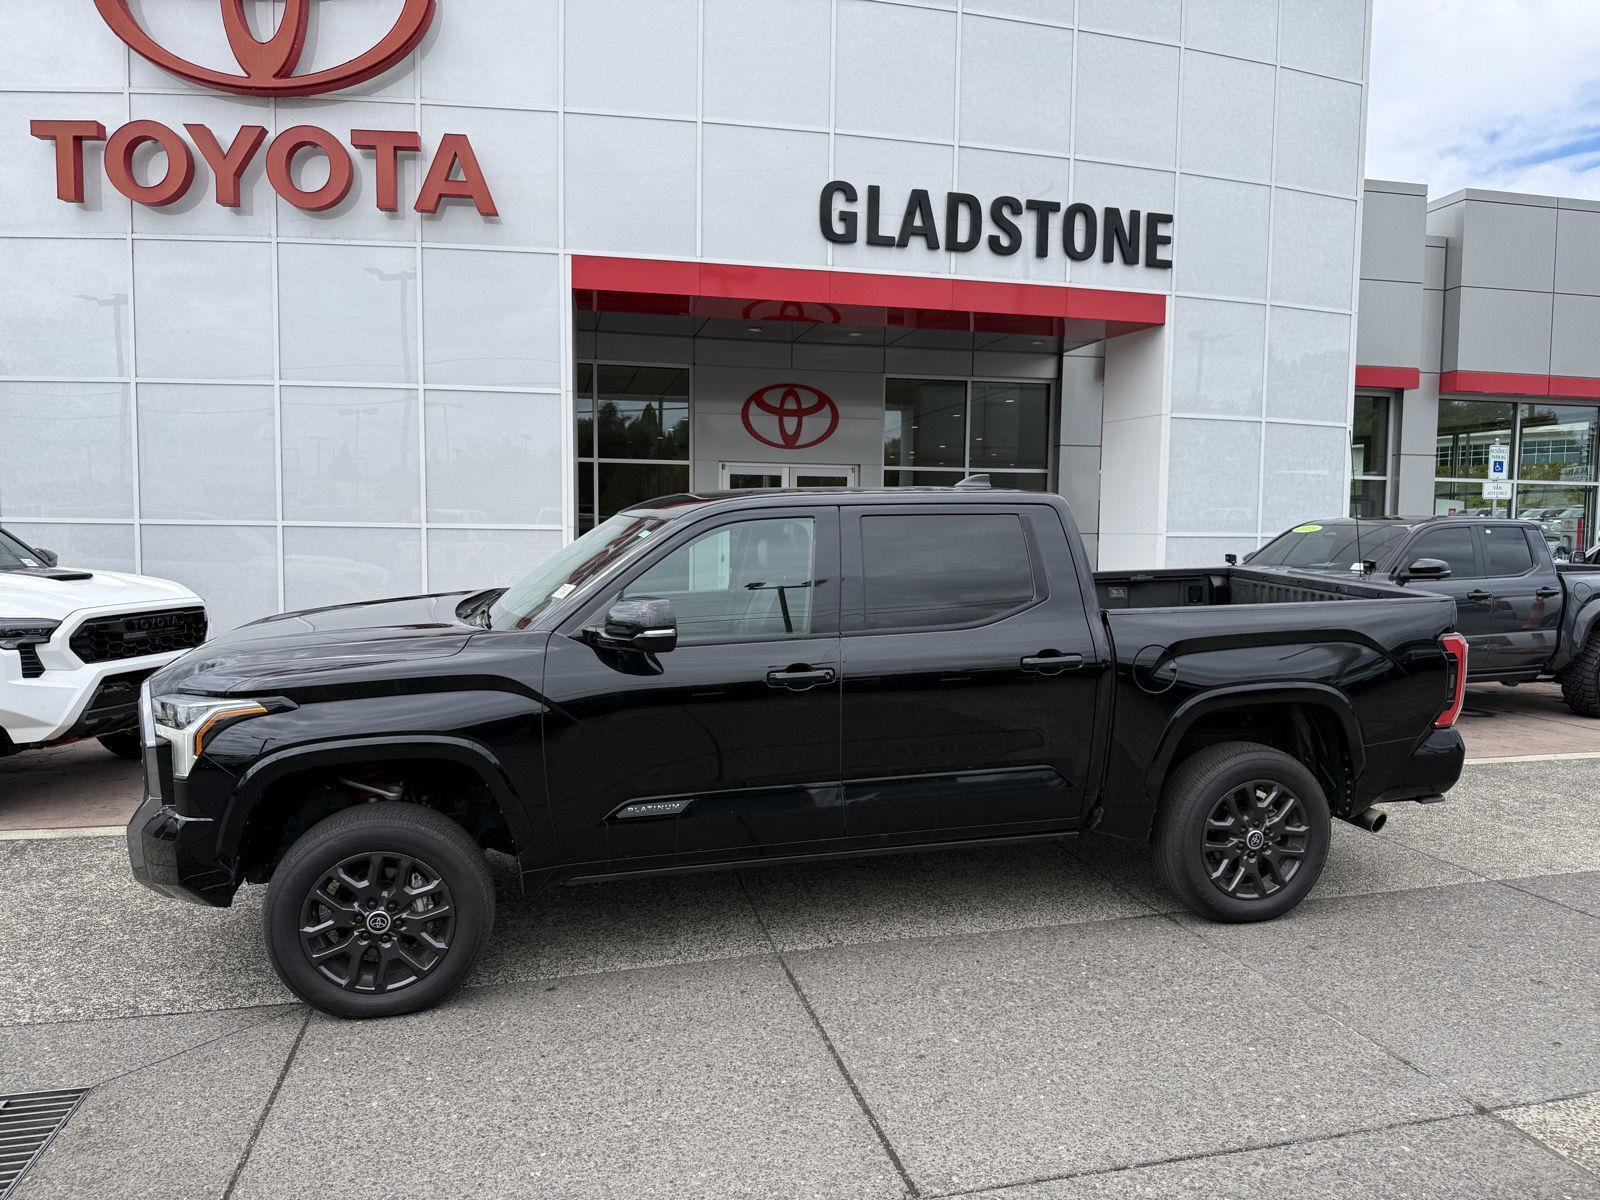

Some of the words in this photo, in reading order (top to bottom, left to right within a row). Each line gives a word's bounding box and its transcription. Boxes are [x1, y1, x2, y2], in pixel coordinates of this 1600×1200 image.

[30, 119, 499, 217] TOYOTA
[819, 180, 1173, 269] GLADSTONE
[132, 616, 179, 629] TOYOTA
[628, 803, 680, 812] PLATINUM
